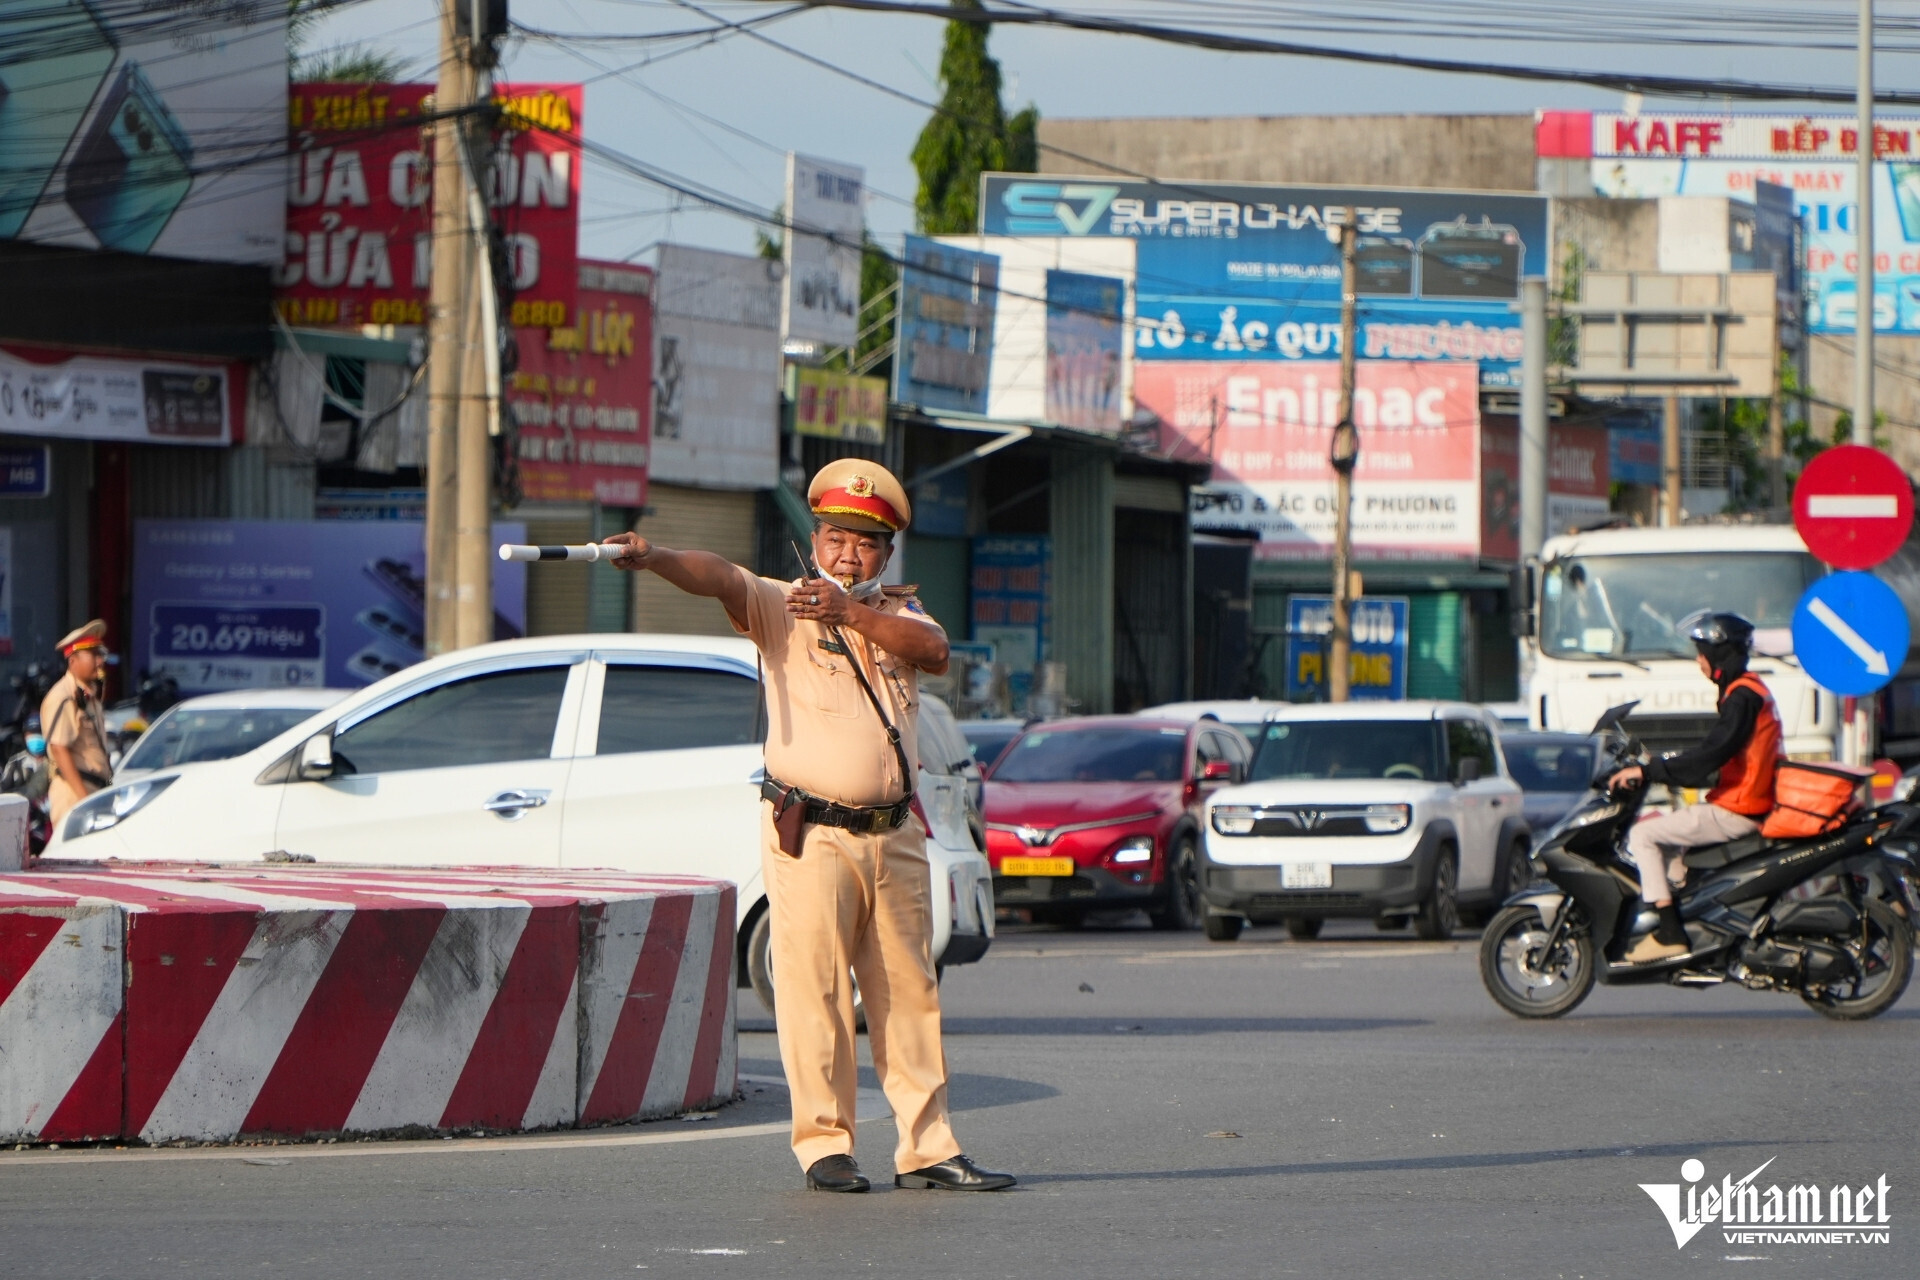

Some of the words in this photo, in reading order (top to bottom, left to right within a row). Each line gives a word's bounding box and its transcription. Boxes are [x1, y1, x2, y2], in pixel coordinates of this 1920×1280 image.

[1615, 119, 1722, 155] KAFF
[1771, 116, 1829, 153] BẾP
[1840, 122, 1909, 159] ĐỆN
[289, 131, 370, 207] ỬA
[1793, 169, 1844, 192] MÁY
[1110, 199, 1239, 228] SUPER
[1844, 251, 1890, 273] CO
[1136, 309, 1186, 349] TÔ
[1213, 306, 1268, 351] ẮC
[1227, 373, 1446, 427] Enimac
[171, 623, 251, 651] 20.69
